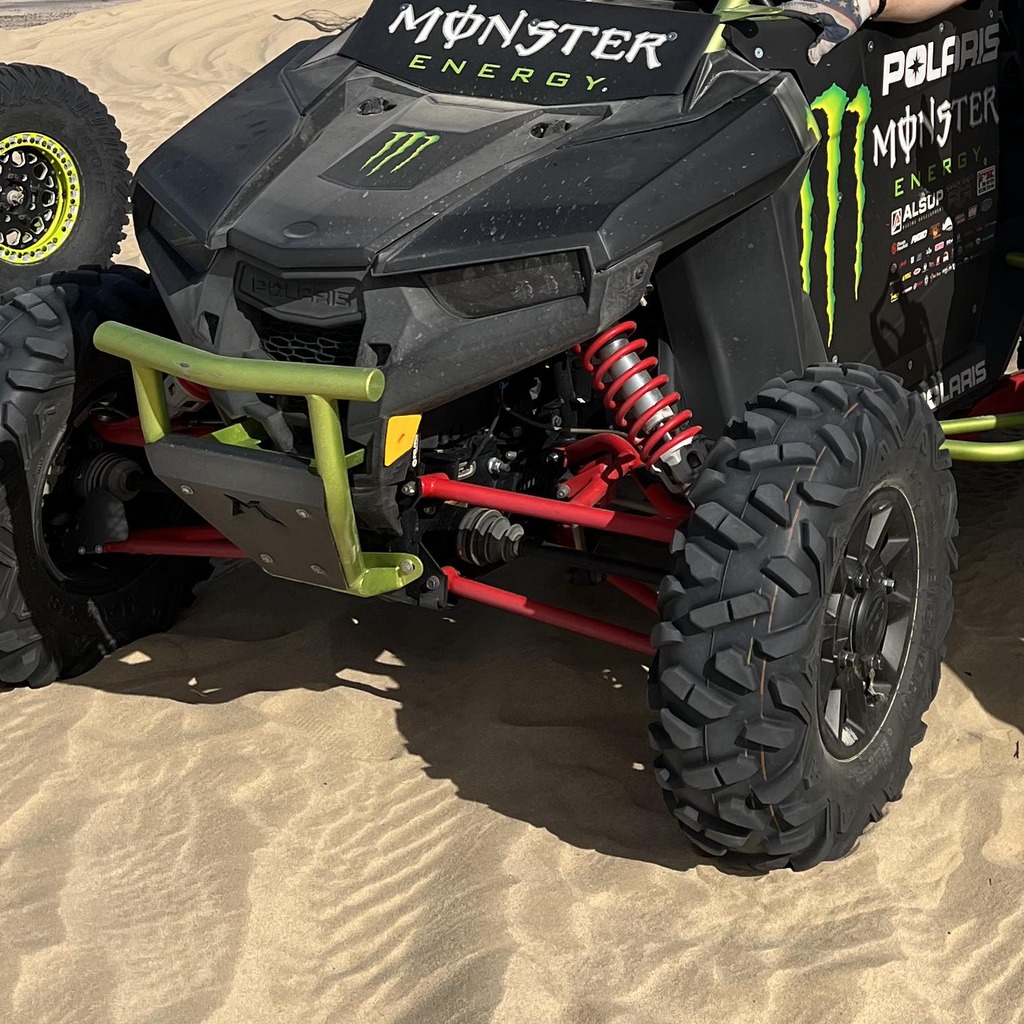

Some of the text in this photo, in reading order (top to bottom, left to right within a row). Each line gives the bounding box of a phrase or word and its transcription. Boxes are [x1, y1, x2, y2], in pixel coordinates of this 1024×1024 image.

[388, 3, 669, 69] MONSTER
[882, 23, 1000, 96] POLARIS
[408, 54, 607, 92] ENERGY
[872, 85, 999, 169] MONSTER
[894, 145, 981, 197] ENERGY
[903, 188, 944, 220] ALSUP
